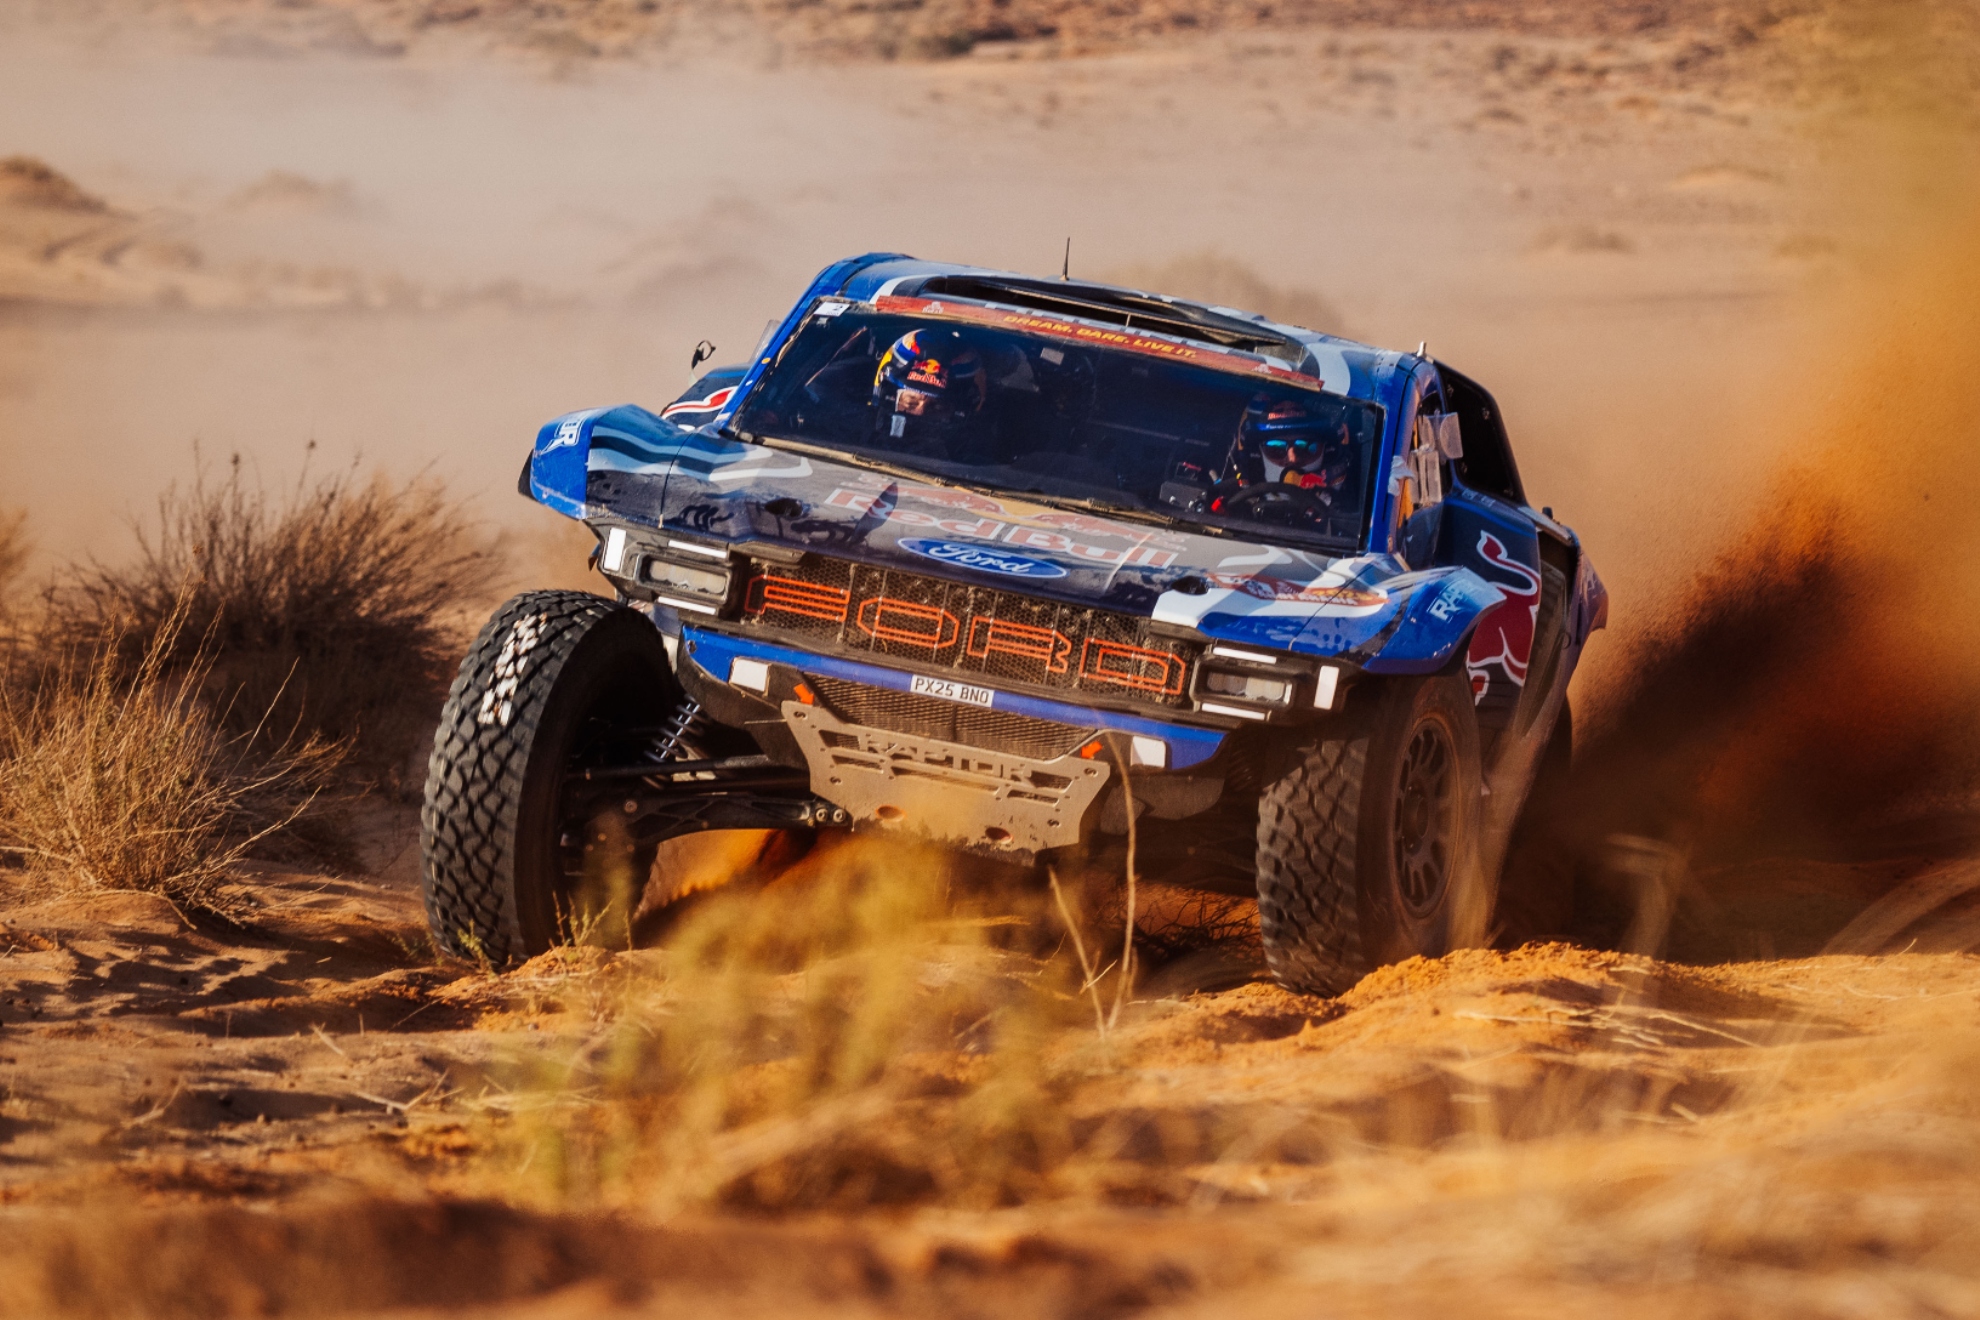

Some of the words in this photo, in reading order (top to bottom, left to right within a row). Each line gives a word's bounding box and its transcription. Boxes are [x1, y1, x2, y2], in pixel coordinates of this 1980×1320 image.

[1003, 315, 1073, 333] DREAM.
[1076, 328, 1130, 344] DARE.
[1133, 339, 1176, 353] LIVE
[1176, 348, 1197, 359] IT.
[824, 488, 1002, 540] Red
[1003, 525, 1181, 569] Bull
[928, 543, 1035, 573] Ford
[744, 574, 1187, 696] FORD
[914, 677, 956, 697] PX25
